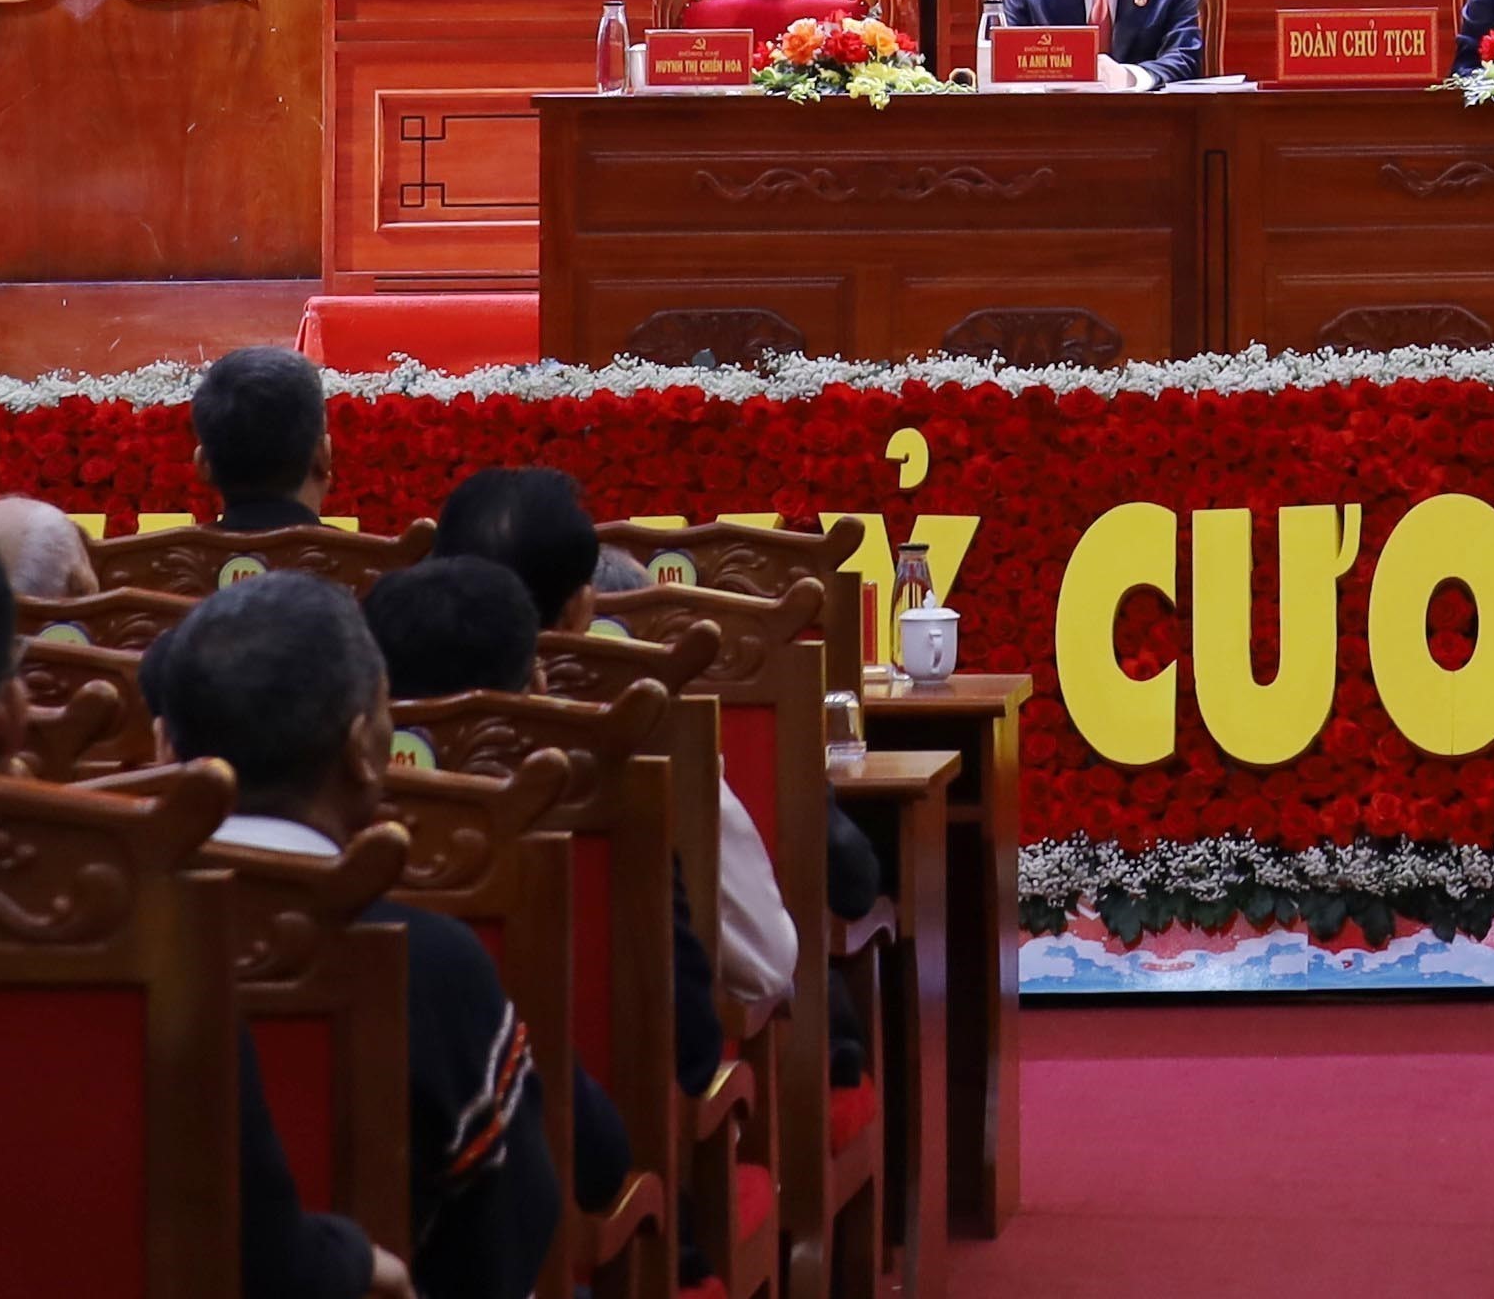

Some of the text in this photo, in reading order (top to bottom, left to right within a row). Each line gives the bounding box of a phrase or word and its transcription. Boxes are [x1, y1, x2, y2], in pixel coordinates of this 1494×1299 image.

[1290, 19, 1425, 63] ĐOÀN CHỦ TỊCH
